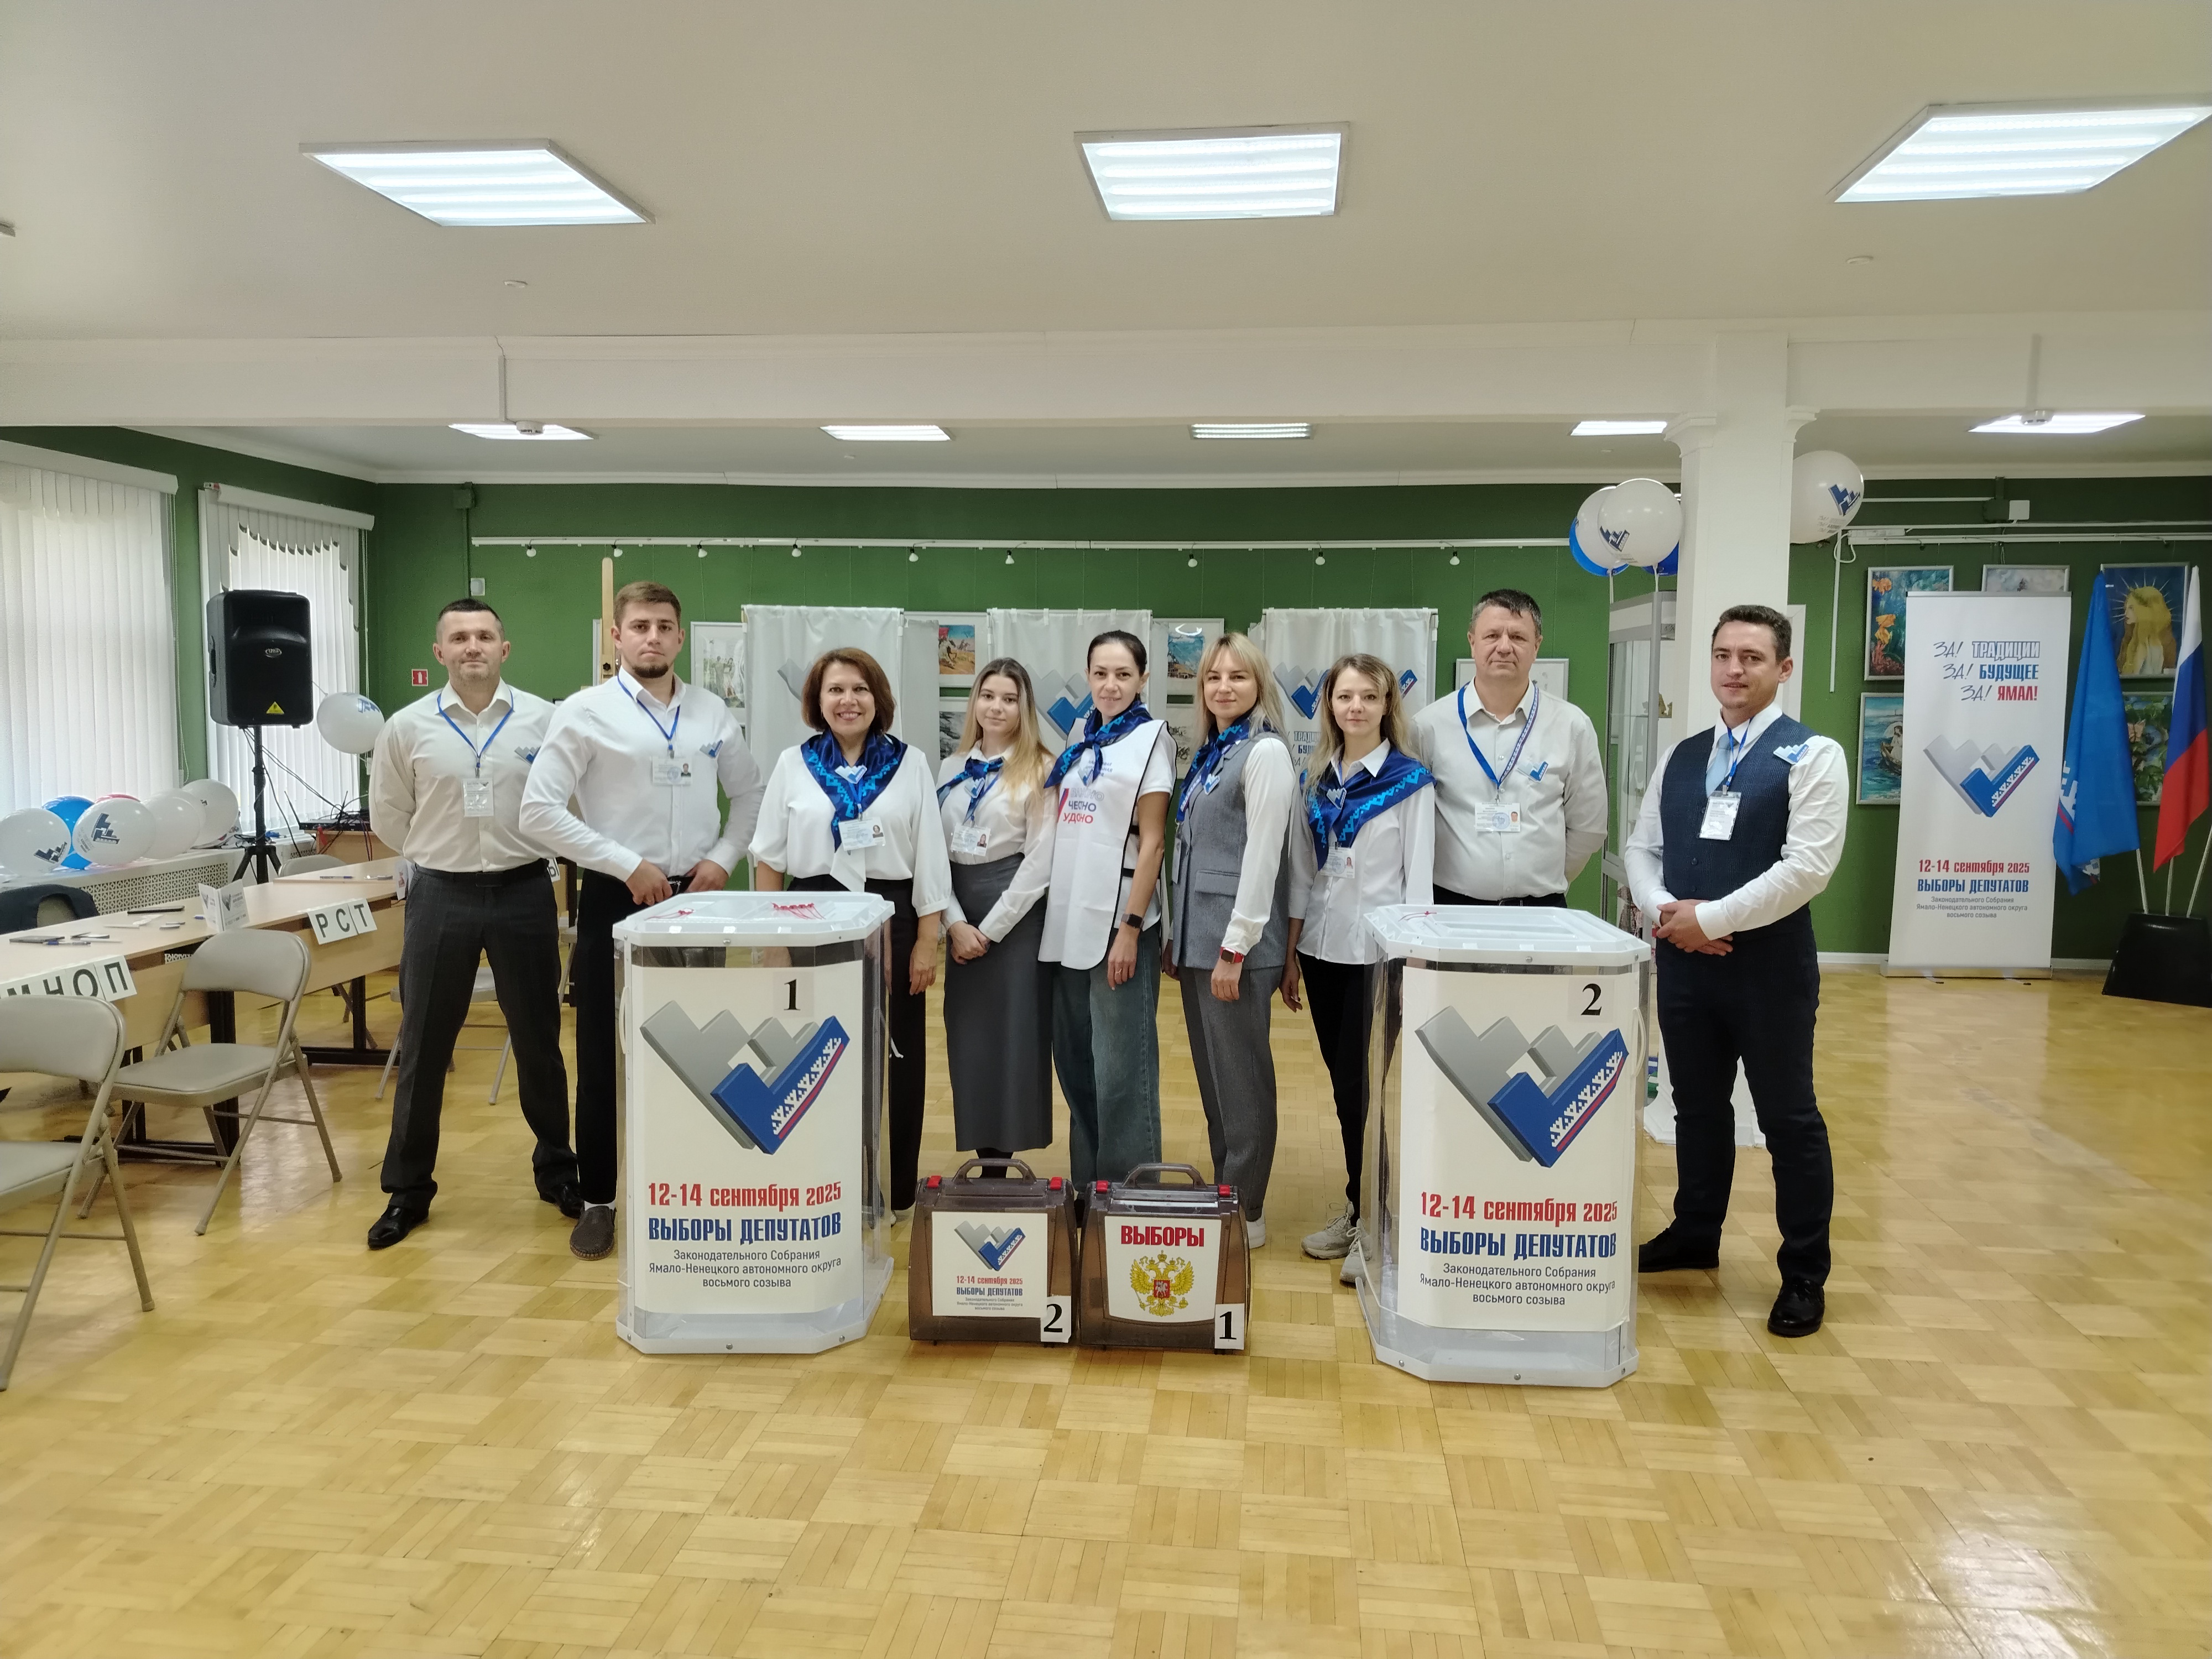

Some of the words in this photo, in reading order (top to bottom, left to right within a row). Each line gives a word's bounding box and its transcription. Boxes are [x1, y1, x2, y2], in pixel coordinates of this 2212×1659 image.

[1933, 641, 1964, 658] ЗА!
[1972, 641, 2040, 661] ТРАДИЦИИ
[1943, 664, 1974, 680] ЗА!
[1979, 664, 2039, 682] БУДУЩЕЕ
[1960, 685, 1992, 701] ЗА!
[1997, 686, 2038, 701] ЯМАЛ!
[1919, 859, 1949, 873] 12-14
[1954, 860, 2004, 876] сентября
[2007, 863, 2030, 873] 2025
[1917, 879, 1965, 892] ВЫБОРЫ
[1969, 879, 2029, 894] ДЕПУТАТОВ
[784, 979, 801, 1011] 1
[1580, 983, 1602, 1015] 2
[649, 1183, 702, 1207] 12-14
[710, 1184, 800, 1212] сентября
[806, 1181, 841, 1206] 2025
[1421, 1191, 1475, 1219] 12-14
[1484, 1198, 1576, 1227] сентября
[1583, 1201, 1617, 1222] 2025
[649, 1218, 732, 1241] ВЫБОРЫ
[740, 1212, 841, 1246] ДЕПУТАТОВ
[1121, 1225, 1204, 1247] ВЫБОРЫ
[1421, 1227, 1506, 1256] ВЫБОРЫ
[1514, 1233, 1616, 1261] ДЕПУТАТОВ
[674, 1250, 768, 1262] Законодательного
[771, 1250, 820, 1262] Собрания
[649, 1263, 739, 1276] Ямало-Ненецкого
[742, 1264, 808, 1274] автономного
[811, 1258, 841, 1273] округа
[1443, 1263, 1542, 1276] Законодательного
[1545, 1266, 1596, 1280] Собрания
[703, 1279, 750, 1287] восьмого
[957, 1275, 975, 1284] 12-14
[978, 1276, 1007, 1286] сентября
[1420, 1274, 1512, 1290] Ямало-Ненецкого
[1515, 1281, 1583, 1291] автономного
[1586, 1280, 1615, 1294] округа
[988, 1287, 1022, 1296] ДЕПУТАТОВ
[1473, 1293, 1522, 1304] восьмого
[1526, 1296, 1565, 1305] созыва
[1044, 1303, 1063, 1333] 2
[1219, 1311, 1237, 1340] 1
